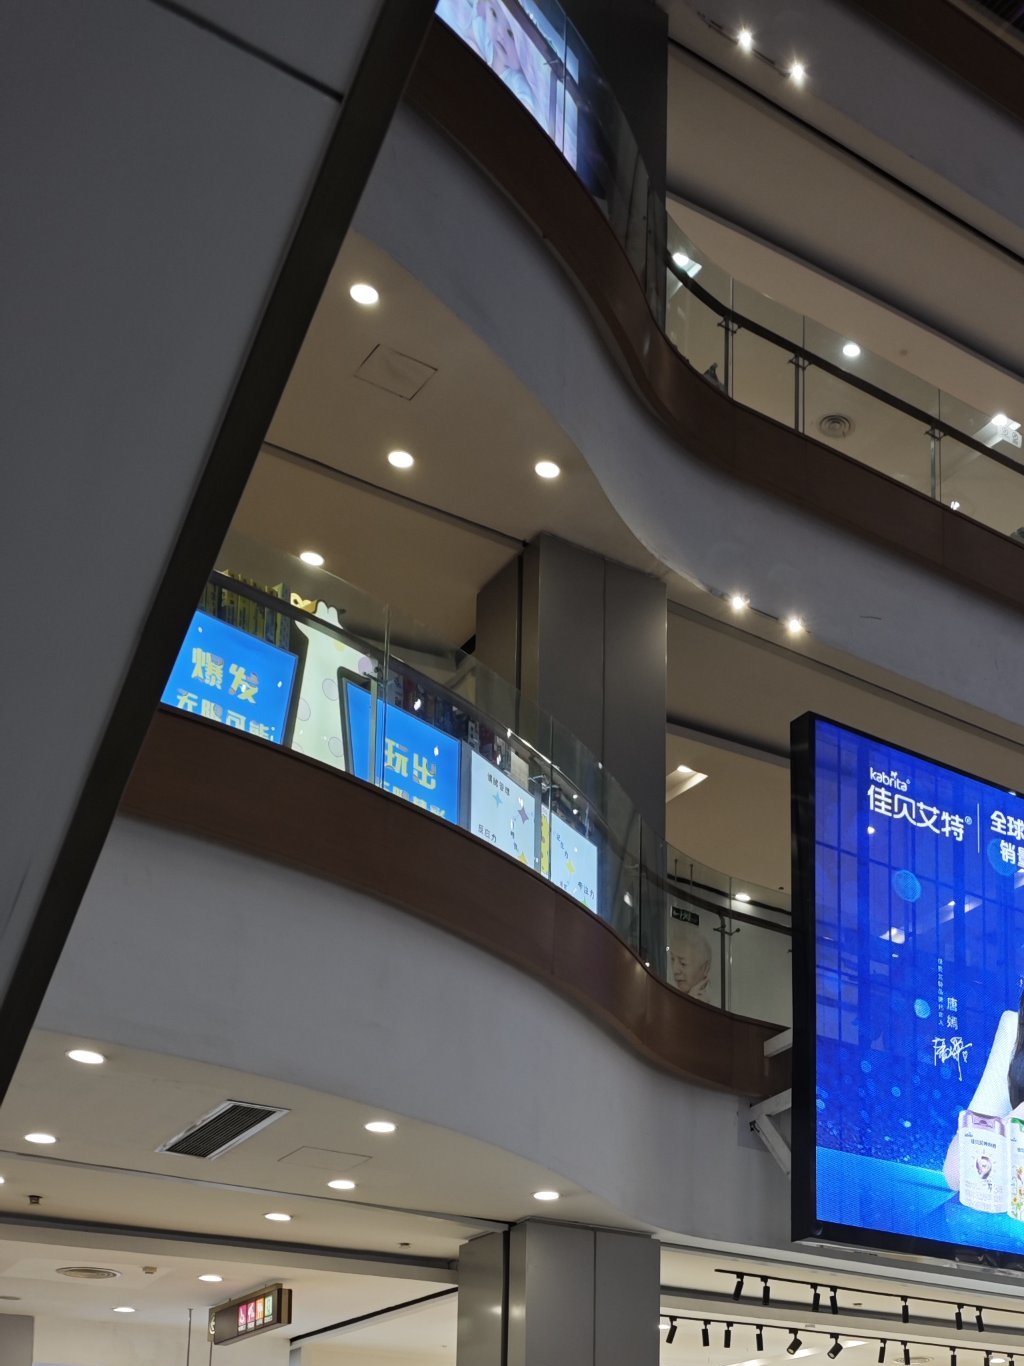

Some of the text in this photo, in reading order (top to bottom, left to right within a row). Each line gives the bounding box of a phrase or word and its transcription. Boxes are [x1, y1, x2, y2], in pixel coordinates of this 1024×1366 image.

[191, 647, 259, 704] 爆发
[384, 738, 438, 790] 玩出
[870, 767, 908, 792] kabrita
[867, 785, 965, 842] 佳贝艾特
